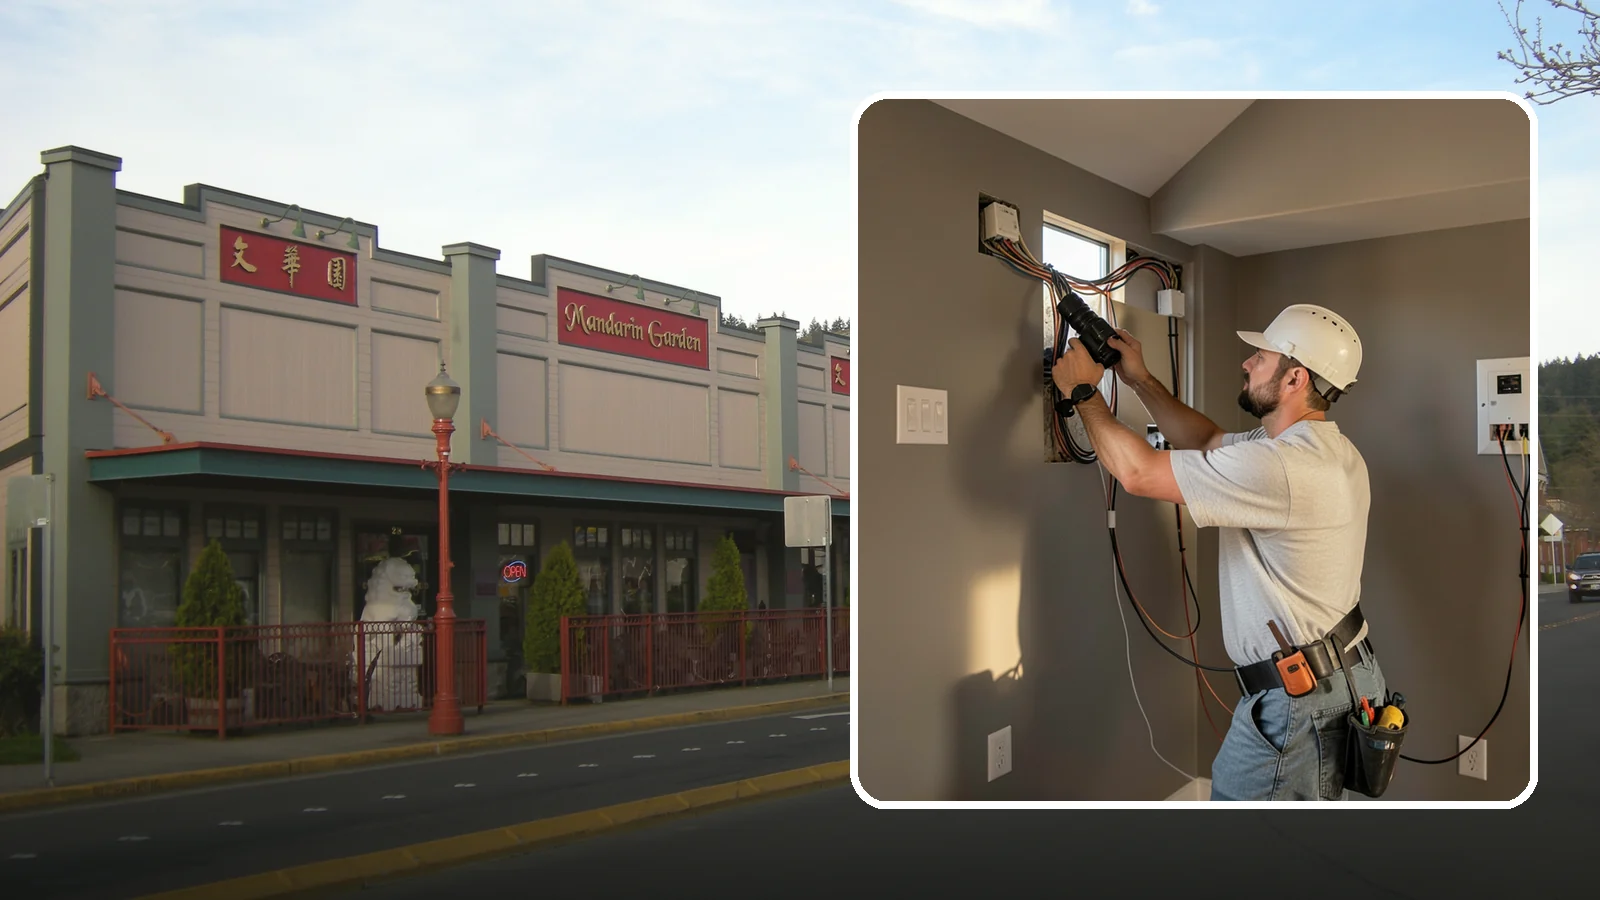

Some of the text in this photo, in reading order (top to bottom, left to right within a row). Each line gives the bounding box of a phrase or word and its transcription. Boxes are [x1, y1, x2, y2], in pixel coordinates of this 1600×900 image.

[230, 235, 347, 292] 文華園
[564, 302, 702, 352] Mandarin Garden
[503, 565, 527, 578] OPEN
